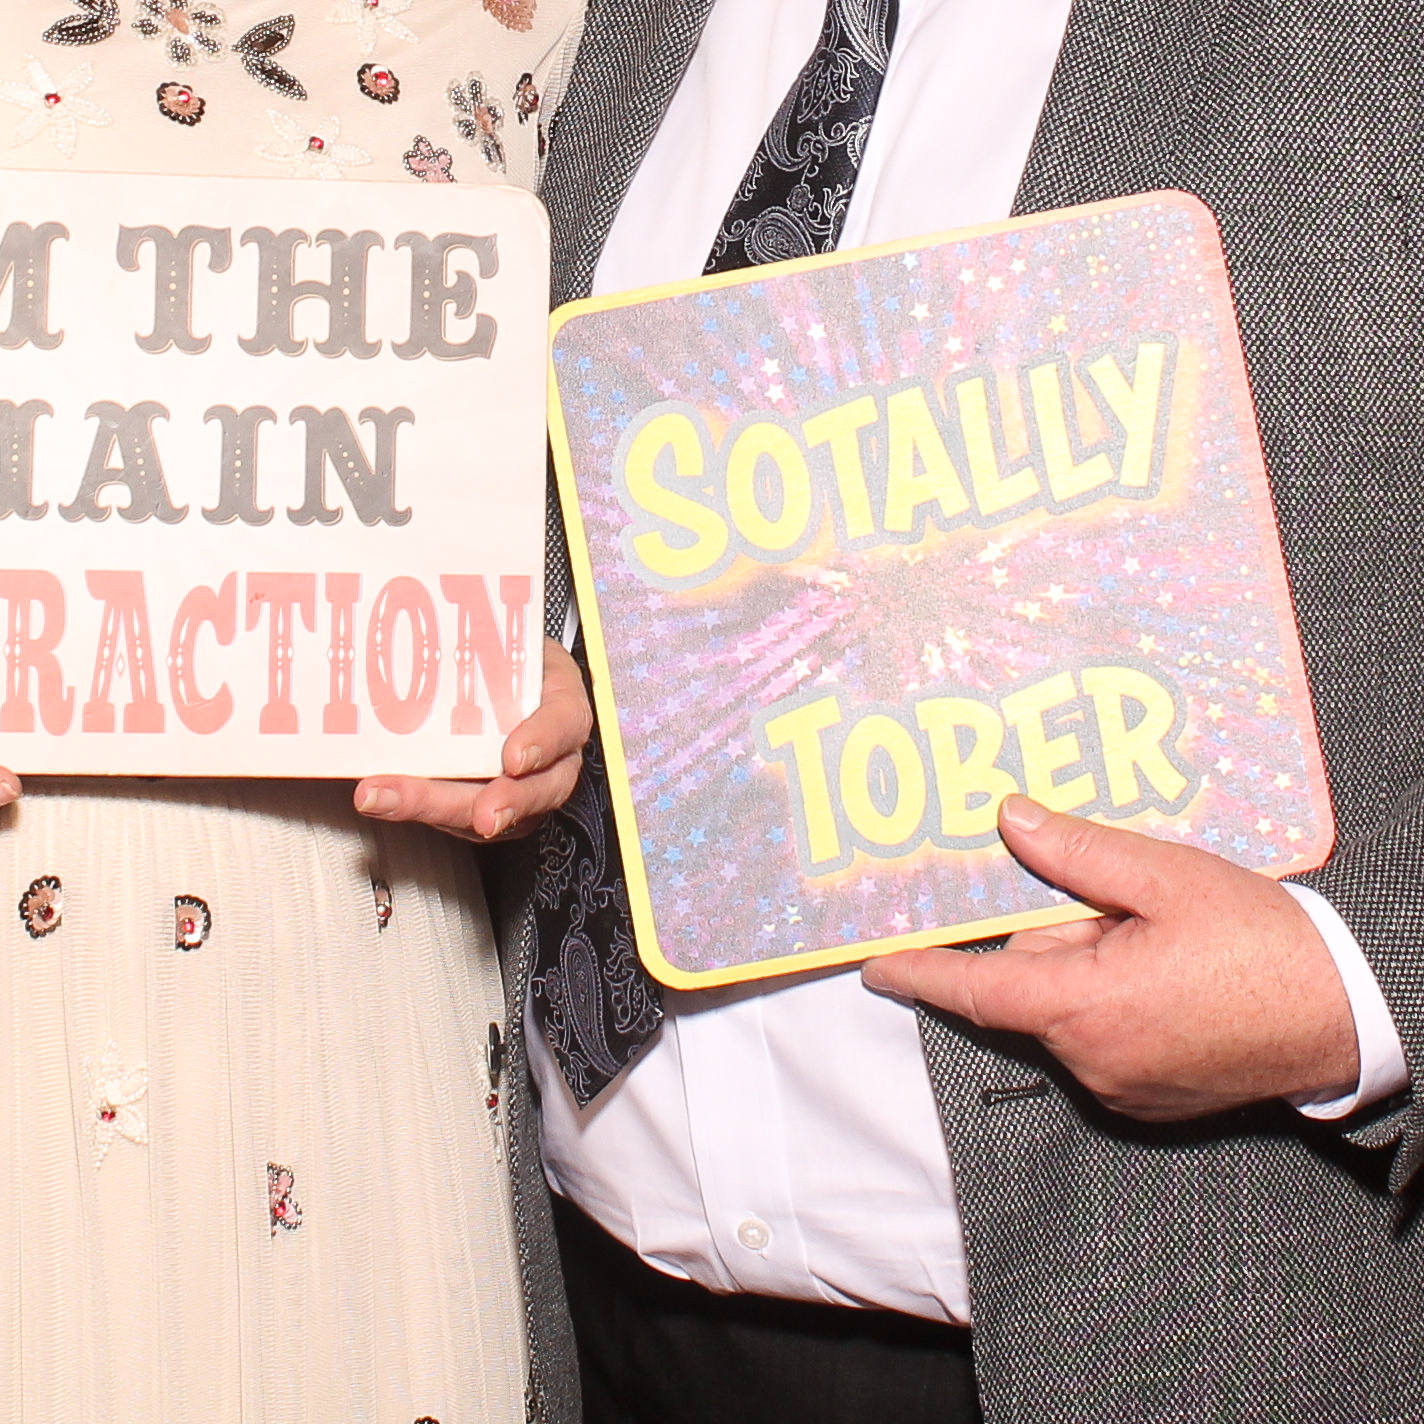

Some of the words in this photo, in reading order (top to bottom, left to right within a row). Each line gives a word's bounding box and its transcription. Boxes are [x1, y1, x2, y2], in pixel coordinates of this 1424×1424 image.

[114, 222, 500, 362] THE
[620, 337, 1170, 582] SOTALLY
[762, 663, 1190, 868] TOBER
